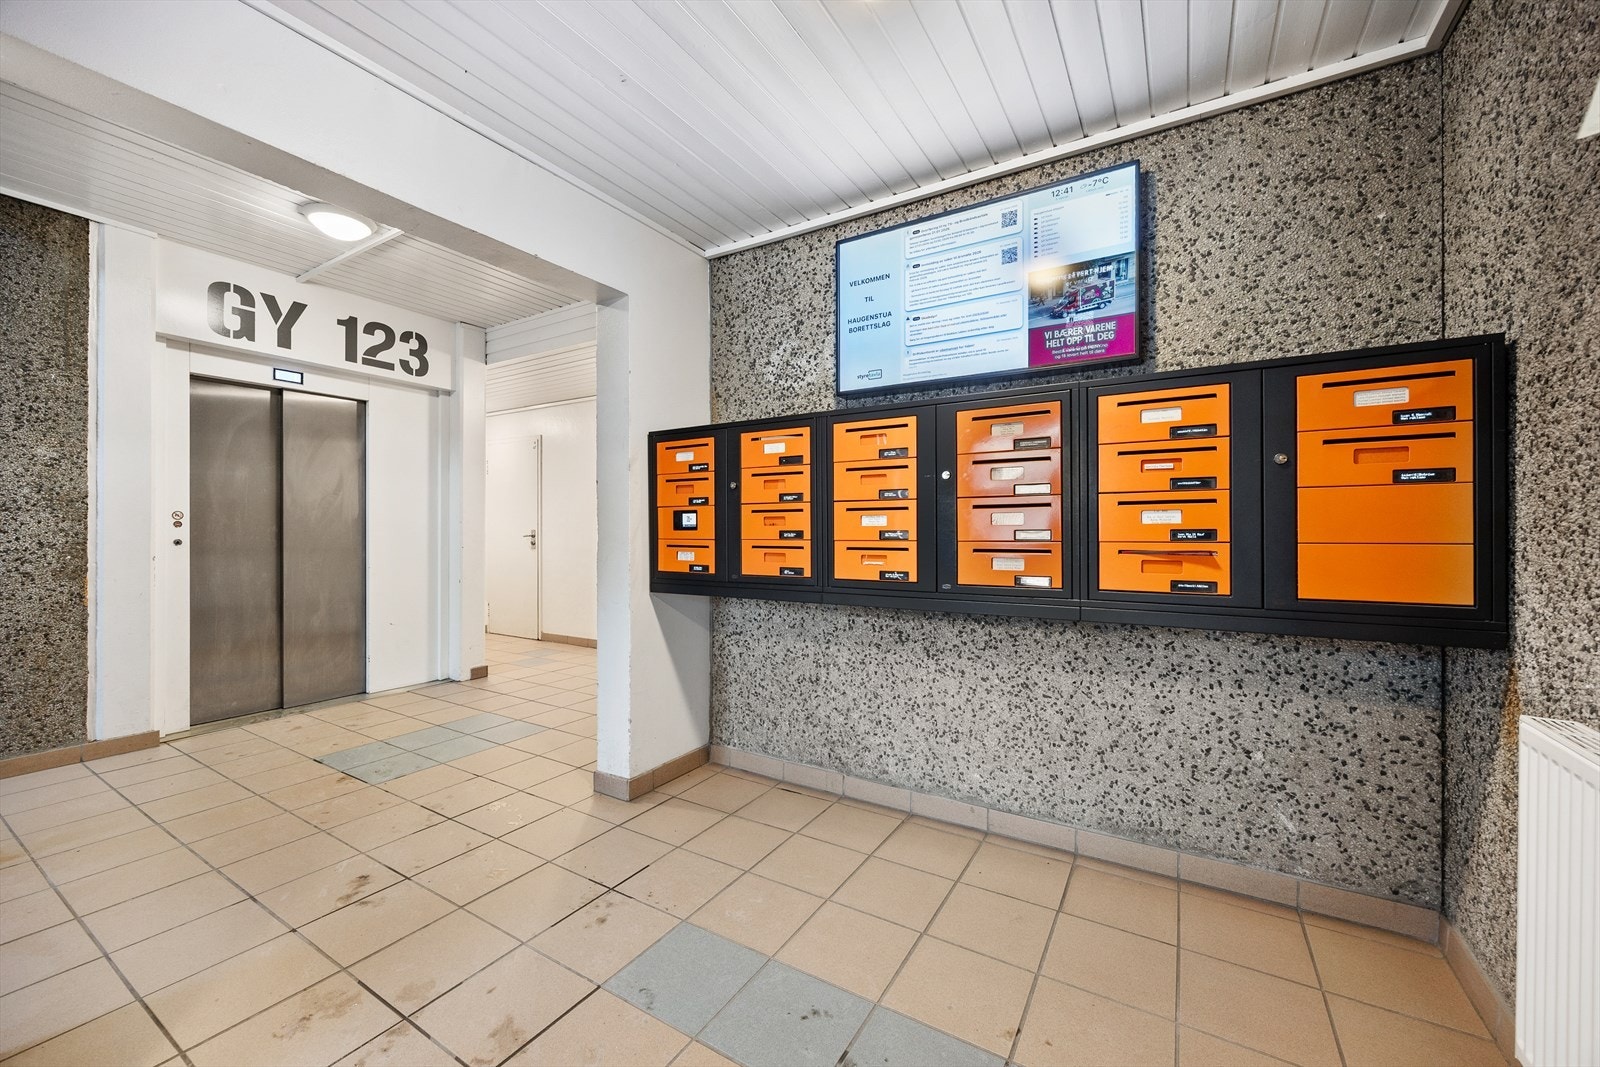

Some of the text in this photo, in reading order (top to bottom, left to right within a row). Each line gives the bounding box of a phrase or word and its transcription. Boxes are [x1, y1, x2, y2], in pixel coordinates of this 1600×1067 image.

[1051, 186, 1074, 198] 12:41
[849, 274, 891, 288] VELKOMMEN
[848, 311, 893, 325] HAUGENSTUA
[207, 281, 430, 378] GY 123
[849, 321, 892, 334] BORETTSLAG
[1045, 321, 1117, 339] VI BÆRER VARENE
[1046, 331, 1115, 348] HELT OPP TIL DEG
